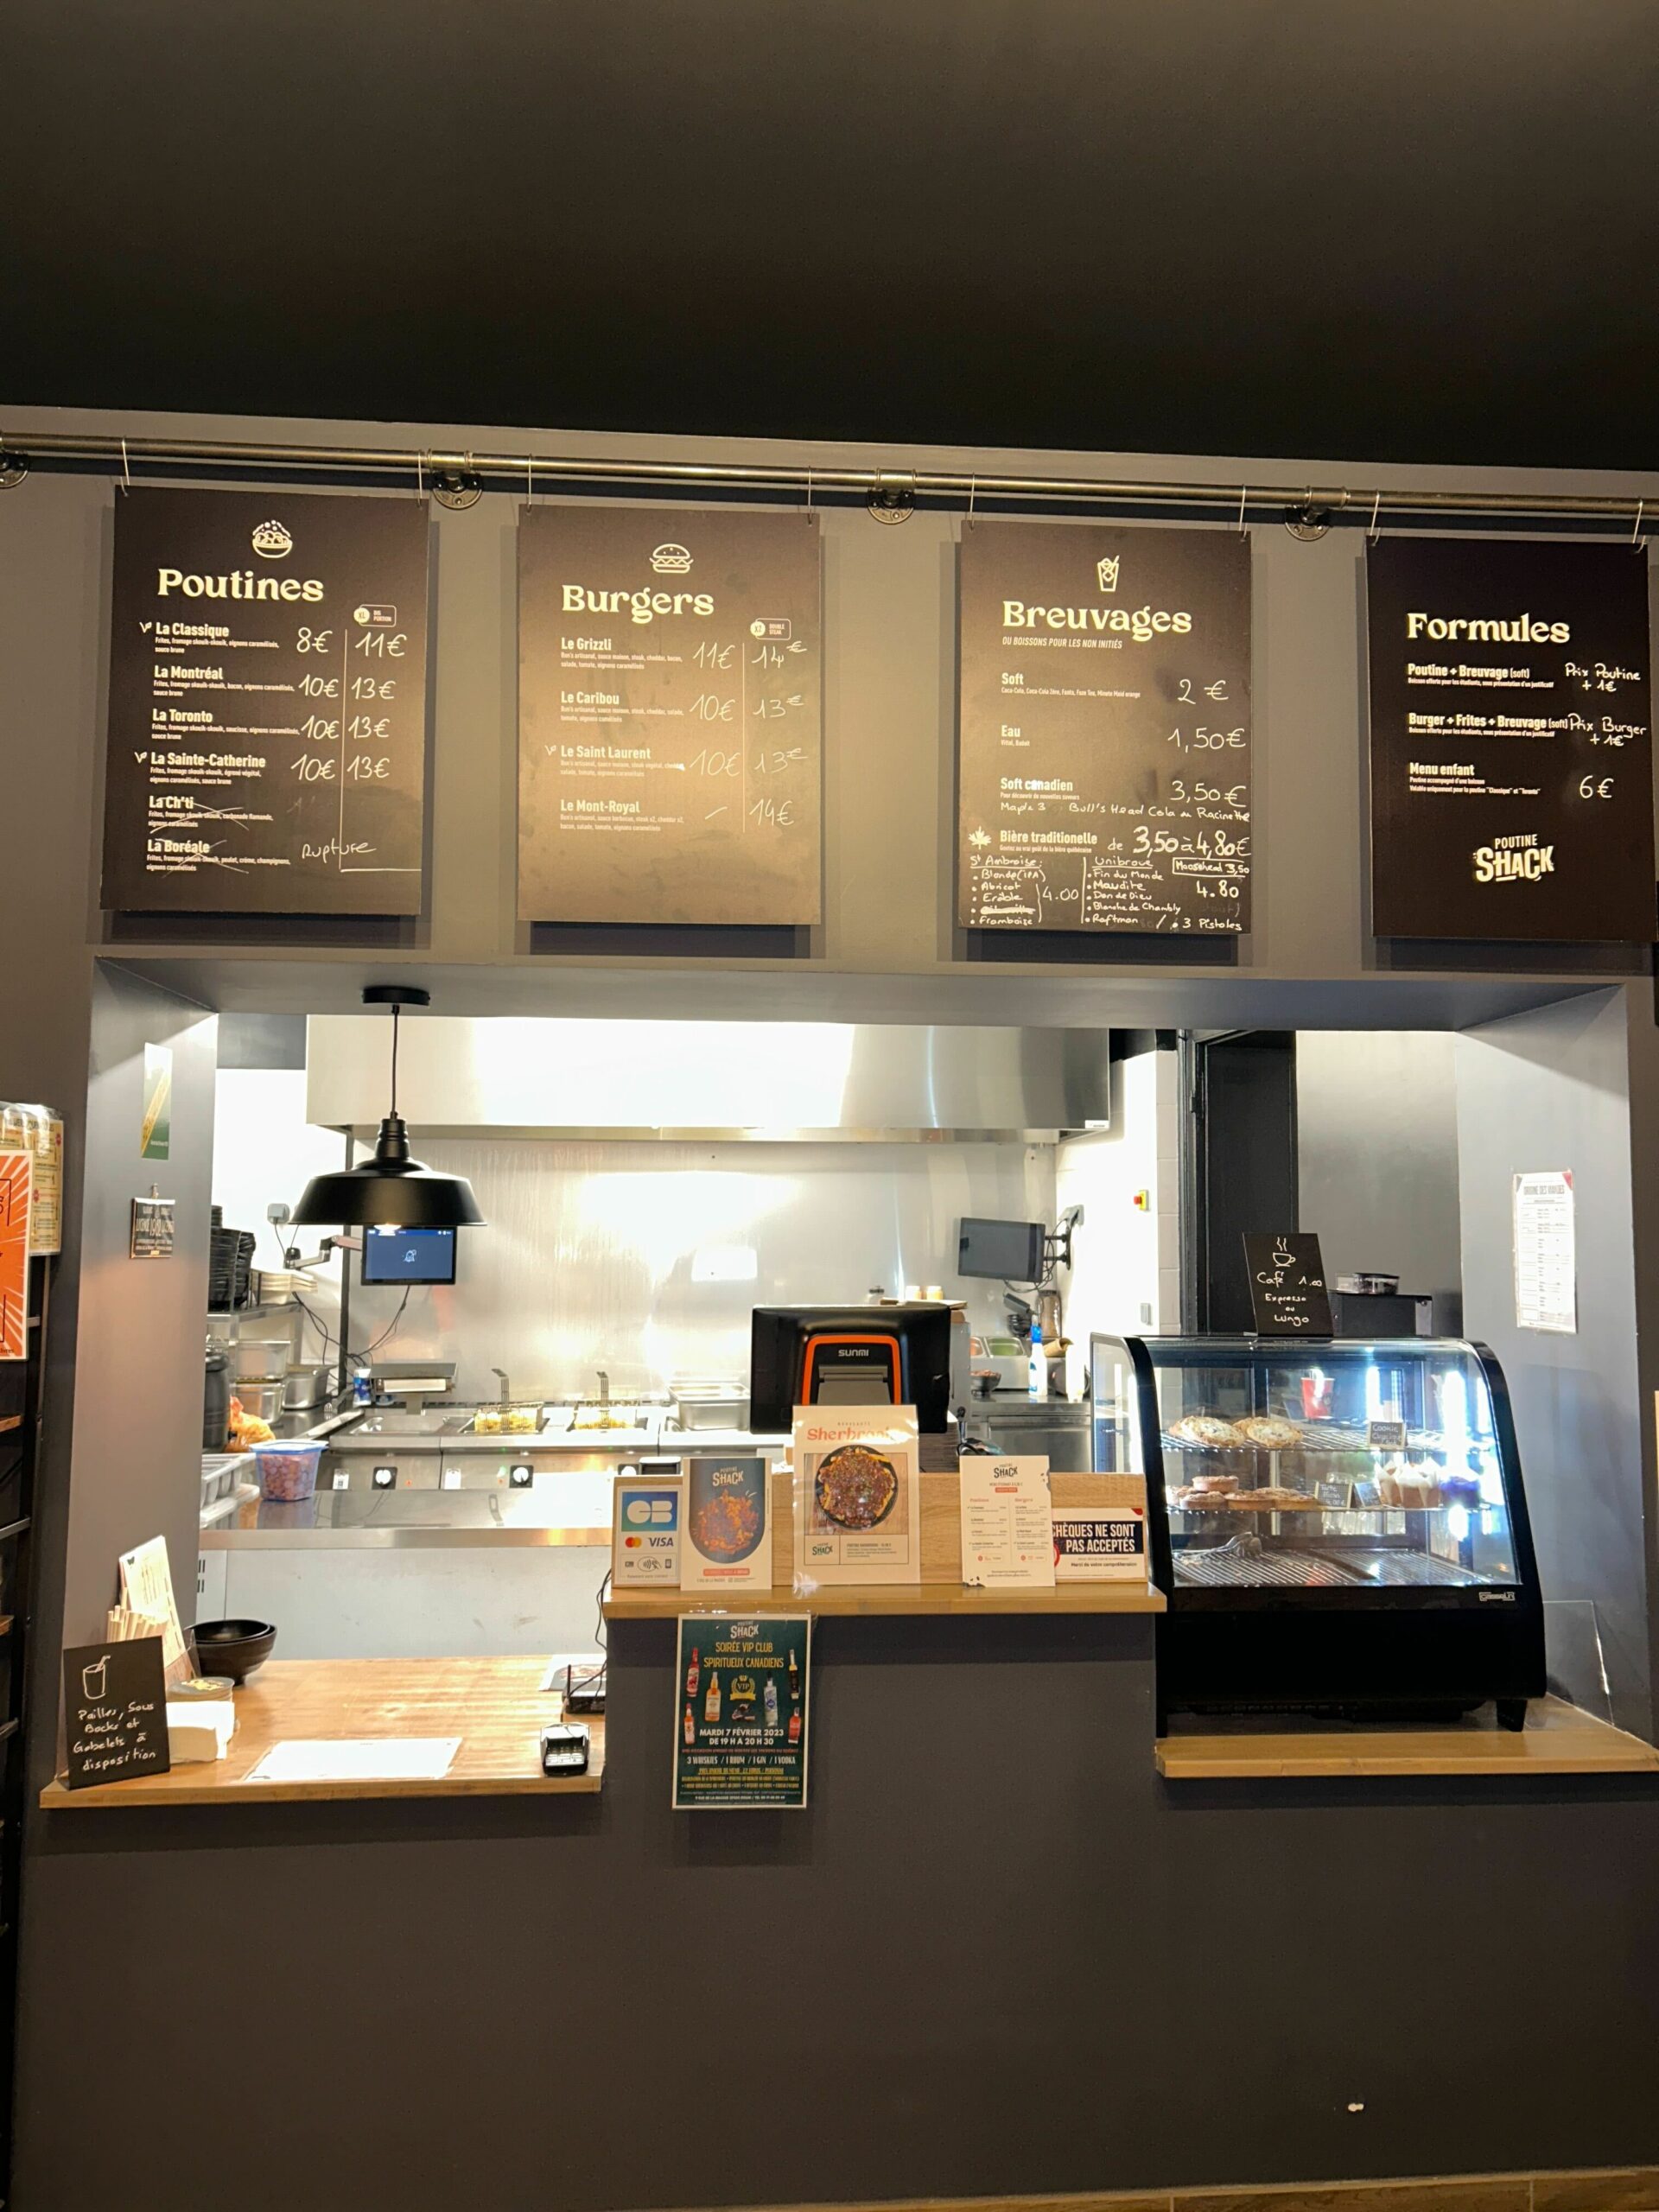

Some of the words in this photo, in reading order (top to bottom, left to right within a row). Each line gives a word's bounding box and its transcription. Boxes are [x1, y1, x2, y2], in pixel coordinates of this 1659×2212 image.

[157, 569, 324, 601] Poutines
[562, 584, 715, 625] Burgers
[358, 611, 366, 620] XL
[1002, 601, 1192, 642] Breuvages
[156, 622, 169, 635] La
[172, 623, 230, 639] Classique
[1407, 613, 1570, 644] Formules
[296, 626, 333, 653] 8€
[355, 632, 407, 658] 11€
[561, 637, 575, 650] Le
[576, 638, 612, 651] Grizzli
[1002, 637, 1012, 645] OU
[1014, 637, 1047, 646] BOISSONS
[1048, 638, 1067, 647] POUR
[1068, 639, 1081, 648] LES
[1082, 639, 1097, 648] NON
[1098, 639, 1122, 649] INITIÉS
[693, 641, 736, 670] 11€
[155, 665, 168, 678] La
[171, 666, 223, 680] Montréal
[1001, 672, 1024, 685] Soft
[1408, 663, 1448, 677] Poutine
[1459, 664, 1508, 680] Breuvage
[1510, 668, 1530, 679] (soft)
[1565, 662, 1588, 677] Prix
[1594, 662, 1641, 681] Poutine
[298, 673, 339, 698] 10€
[351, 677, 397, 700] 13€
[1597, 679, 1617, 692] 1€
[561, 690, 575, 703] Le
[576, 691, 620, 705] Caribou
[690, 694, 736, 721] 10€
[152, 709, 167, 721] La
[168, 709, 213, 723] Toronto
[1408, 712, 1446, 728] Burger
[1456, 714, 1486, 727] Frites
[1497, 715, 1547, 730] Breuvage
[1548, 717, 1568, 729] (soft)
[301, 715, 340, 740] 10€
[348, 715, 390, 739] 13€
[1001, 725, 1020, 737] Eau
[1567, 713, 1593, 732] Prix
[1602, 716, 1647, 739] Burger
[1603, 734, 1624, 747] 1€
[151, 752, 165, 765] La
[167, 753, 266, 768] Sainte-Catherine
[561, 746, 574, 757] Le
[576, 746, 606, 758] Saint
[608, 746, 652, 760] Laurent
[290, 753, 335, 781] 10€
[346, 755, 390, 781] 13€
[690, 749, 741, 778] 10€
[1409, 762, 1439, 775] Menu
[1440, 763, 1475, 776] enfant
[1001, 778, 1023, 790] Soft
[1025, 779, 1073, 791] canadien
[149, 795, 163, 809] La
[165, 796, 194, 810] Ch'ti
[561, 799, 574, 811] Le
[576, 799, 640, 815] Mont-Royal
[749, 798, 794, 826] 14€
[1111, 804, 1144, 816] Head
[1148, 806, 1176, 817] Cola
[1000, 830, 1029, 842] Bière
[1031, 831, 1098, 845] traditionelle
[1107, 837, 1123, 851] de
[1133, 826, 1179, 859] 3,50
[1180, 836, 1195, 853] à
[1494, 834, 1538, 849] POUTINE
[148, 839, 162, 852] La
[164, 839, 211, 854] Boréale
[1475, 846, 1554, 882] SHACK
[1093, 868, 1110, 878] Fin
[1113, 869, 1128, 879] du
[981, 881, 1021, 891] Abricot
[1042, 886, 1079, 901] 4.00
[1196, 880, 1239, 899] 4.80
[1141, 902, 1181, 915] Chambly
[1182, 918, 1192, 929] 3
[1198, 918, 1243, 931] Pistoles
[1256, 1271, 1285, 1287] Café
[712, 1471, 744, 1486] SHACK
[994, 1466, 1018, 1478] SHACK
[1095, 1524, 1108, 1537] NE
[1109, 1523, 1135, 1537] SONT
[648, 1537, 674, 1548] VISA
[1065, 1539, 1084, 1553] PAS
[1086, 1537, 1135, 1553] ACCEPTÉS
[730, 1624, 759, 1639] SHACK
[715, 1641, 741, 1653] SOIRÉE
[742, 1642, 754, 1652] VIP
[755, 1642, 773, 1653] CLUB
[703, 1657, 743, 1668] SPIRITUEUX
[745, 1657, 785, 1668] CANADIENS
[128, 1702, 155, 1713] Sous
[126, 1719, 140, 1728] et
[699, 1728, 724, 1737] MARDI
[732, 1727, 762, 1737] FÉVRIER
[82, 1751, 156, 1771] disposition
